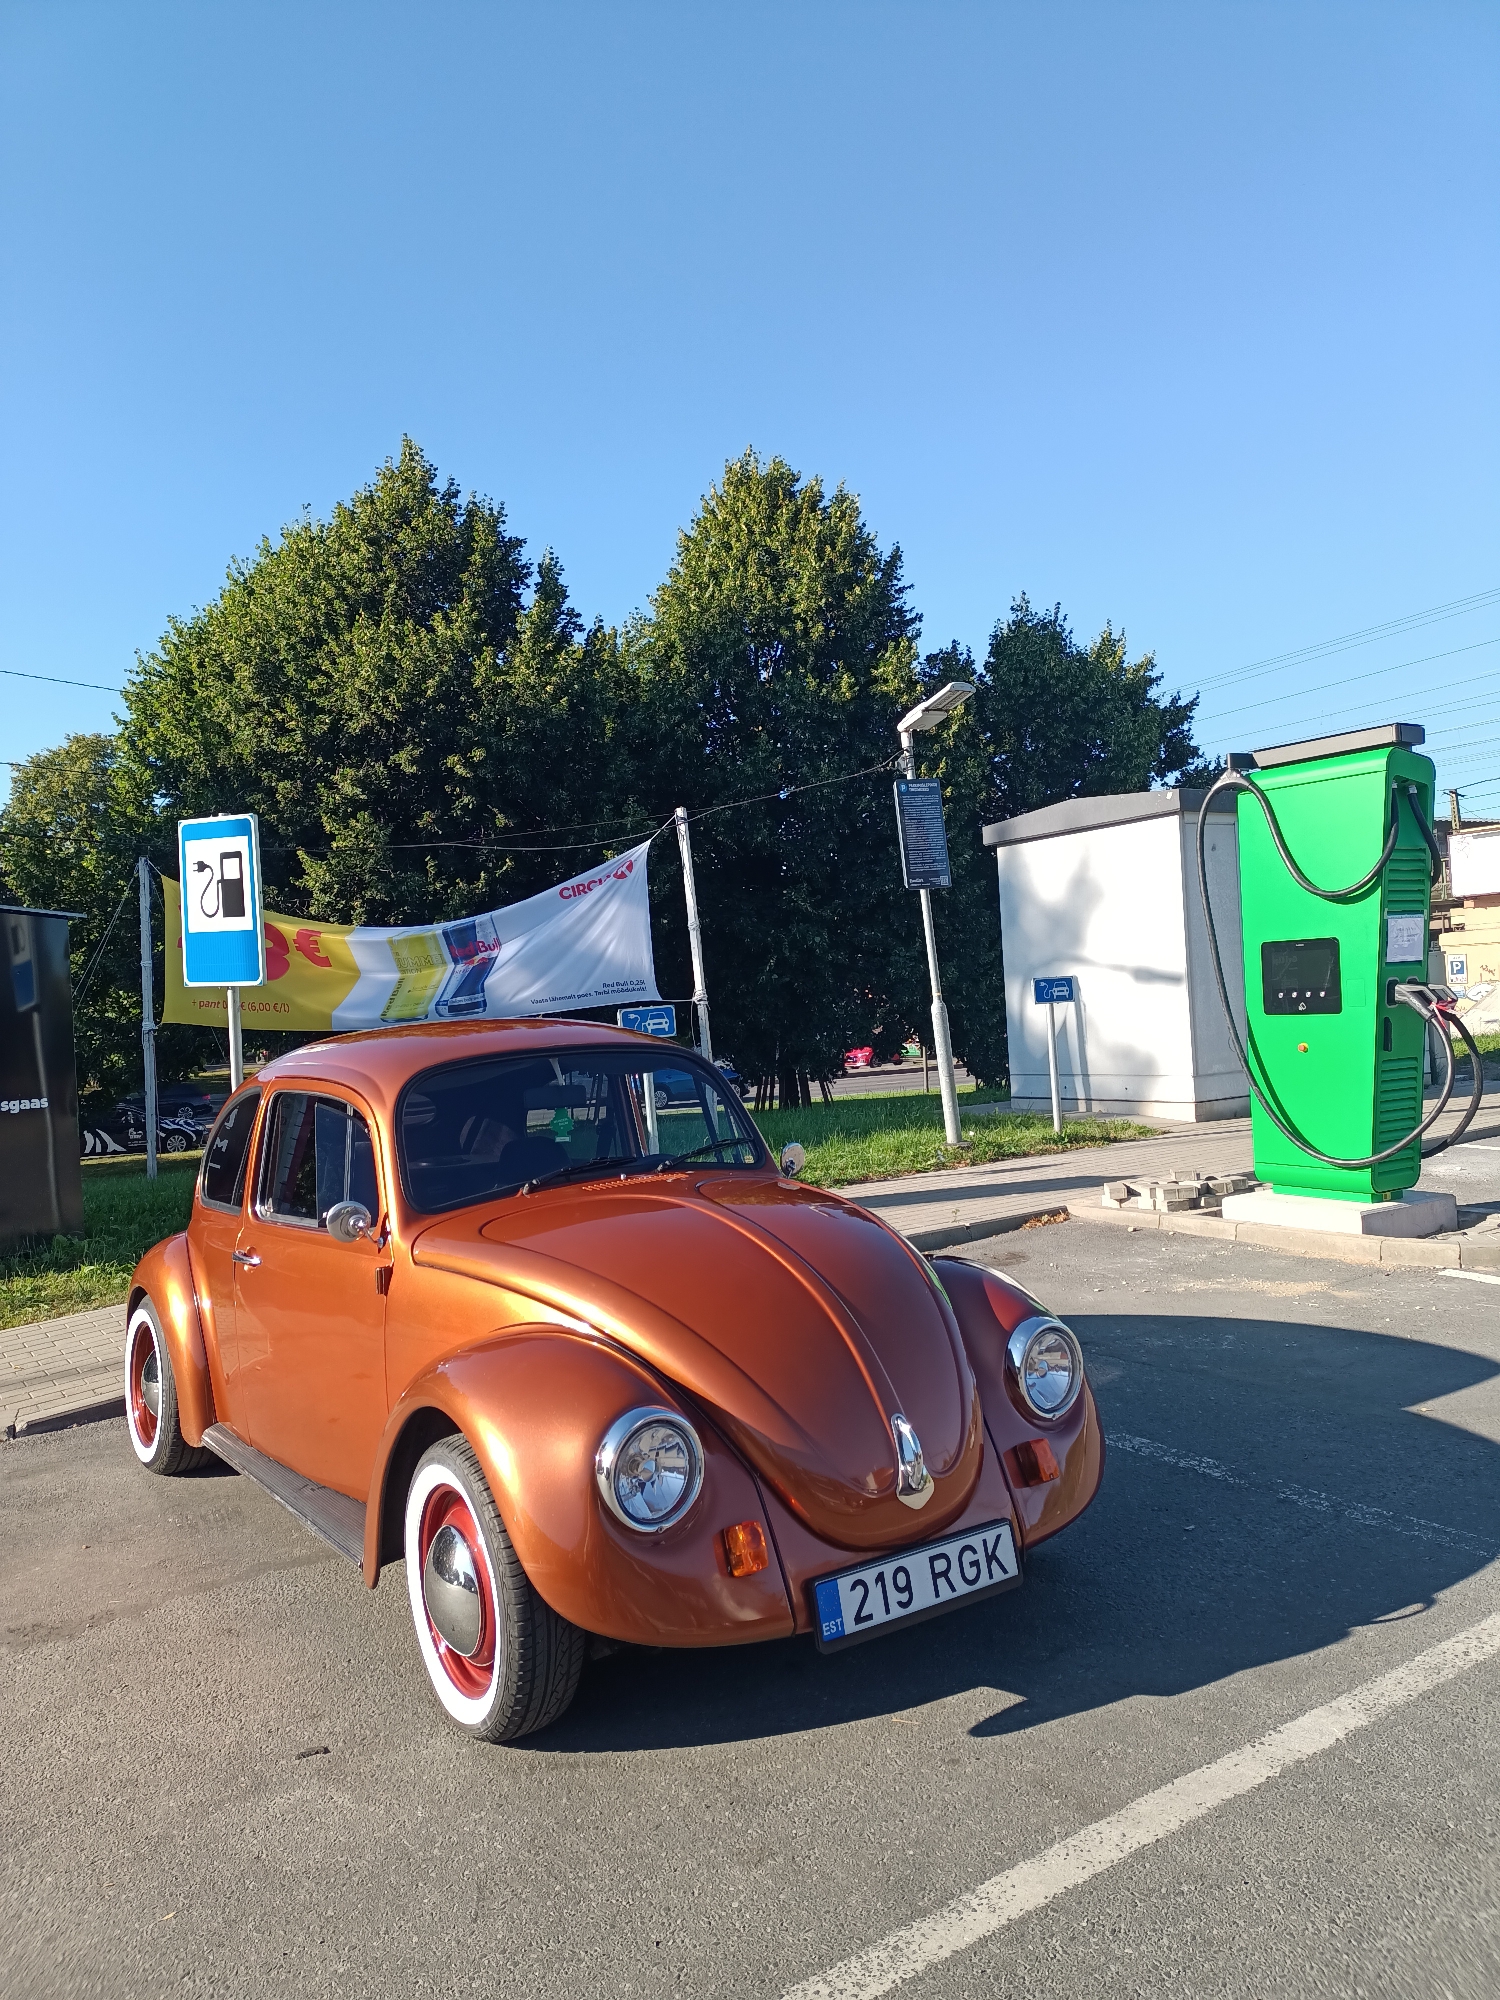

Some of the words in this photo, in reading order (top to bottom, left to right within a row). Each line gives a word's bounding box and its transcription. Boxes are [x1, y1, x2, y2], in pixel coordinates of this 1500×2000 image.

[198, 1000, 221, 1009] pant
[247, 1001, 270, 1013] (6,00
[0, 1097, 49, 1114] sgaas
[849, 1565, 914, 1626] 219
[928, 1533, 1009, 1599] RGK
[822, 1617, 843, 1636] EST
